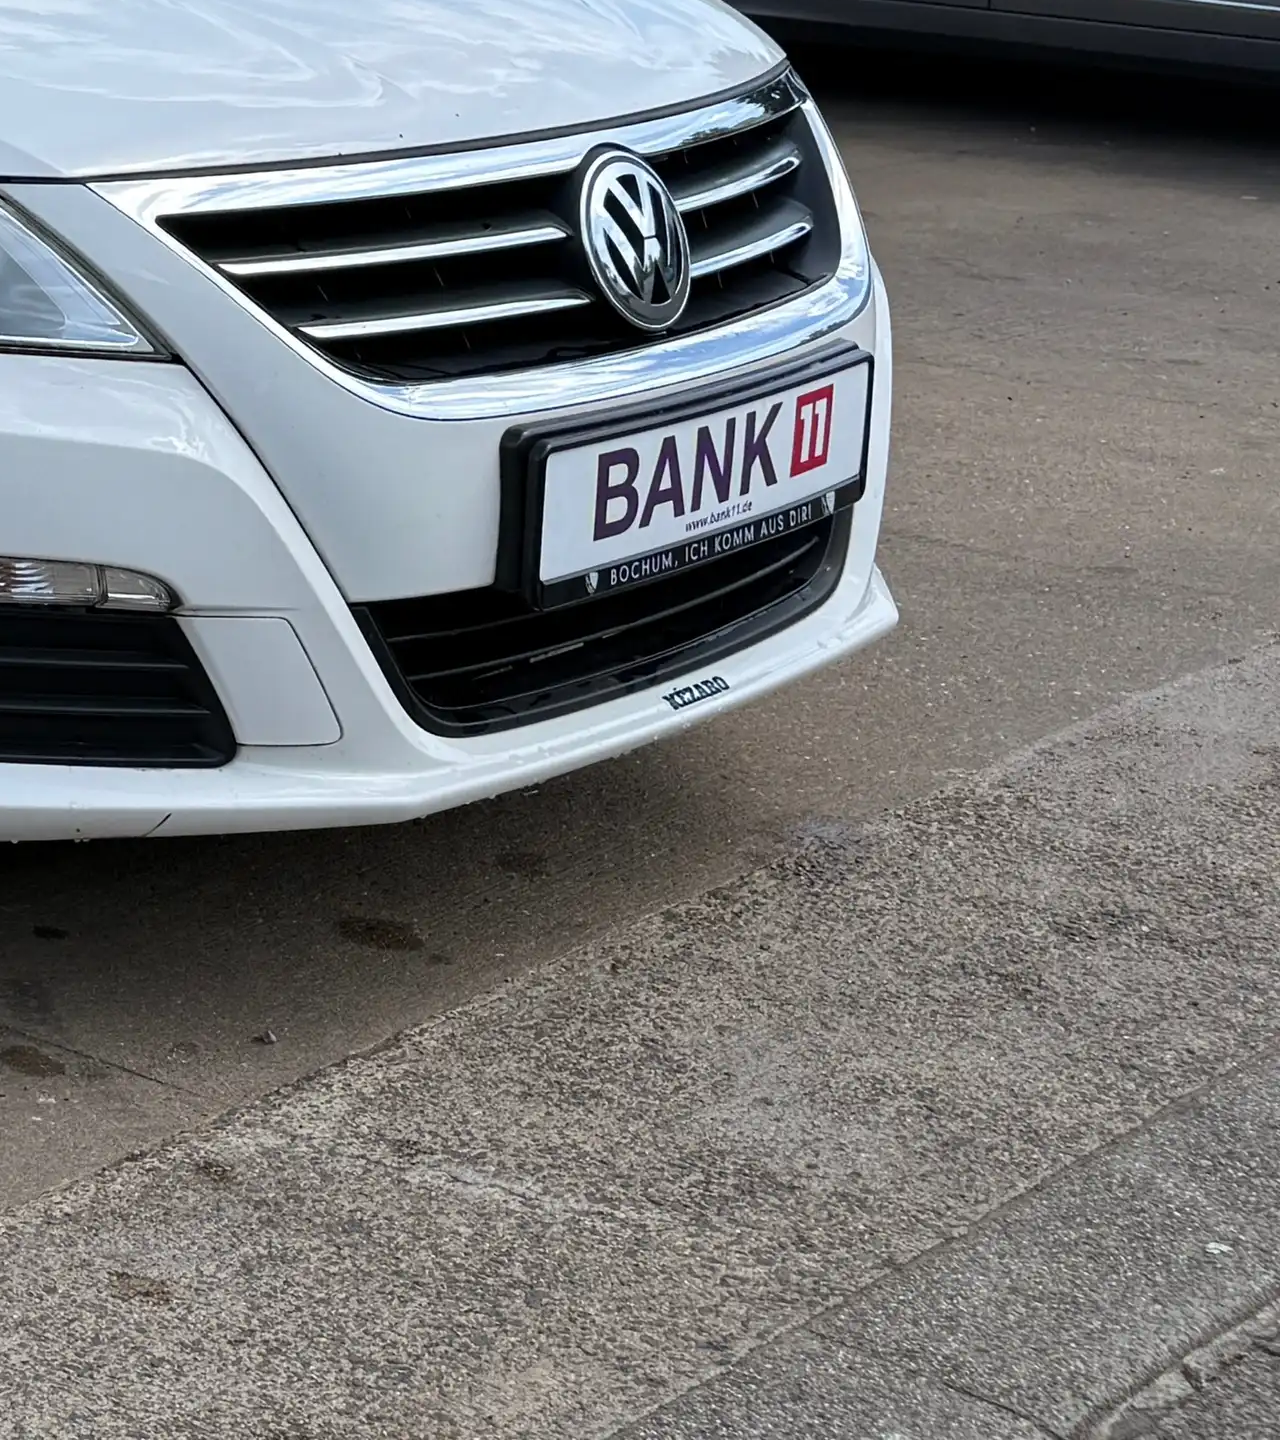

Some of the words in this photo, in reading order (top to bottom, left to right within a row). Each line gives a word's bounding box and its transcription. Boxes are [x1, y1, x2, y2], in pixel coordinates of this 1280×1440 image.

[593, 401, 784, 542] BANK
[798, 394, 829, 466] 11
[609, 551, 678, 586] BOCHUM,
[685, 541, 709, 563] ICH
[714, 524, 755, 553] KOMM
[760, 513, 784, 539] AUS
[685, 500, 753, 532] www.bank11.de
